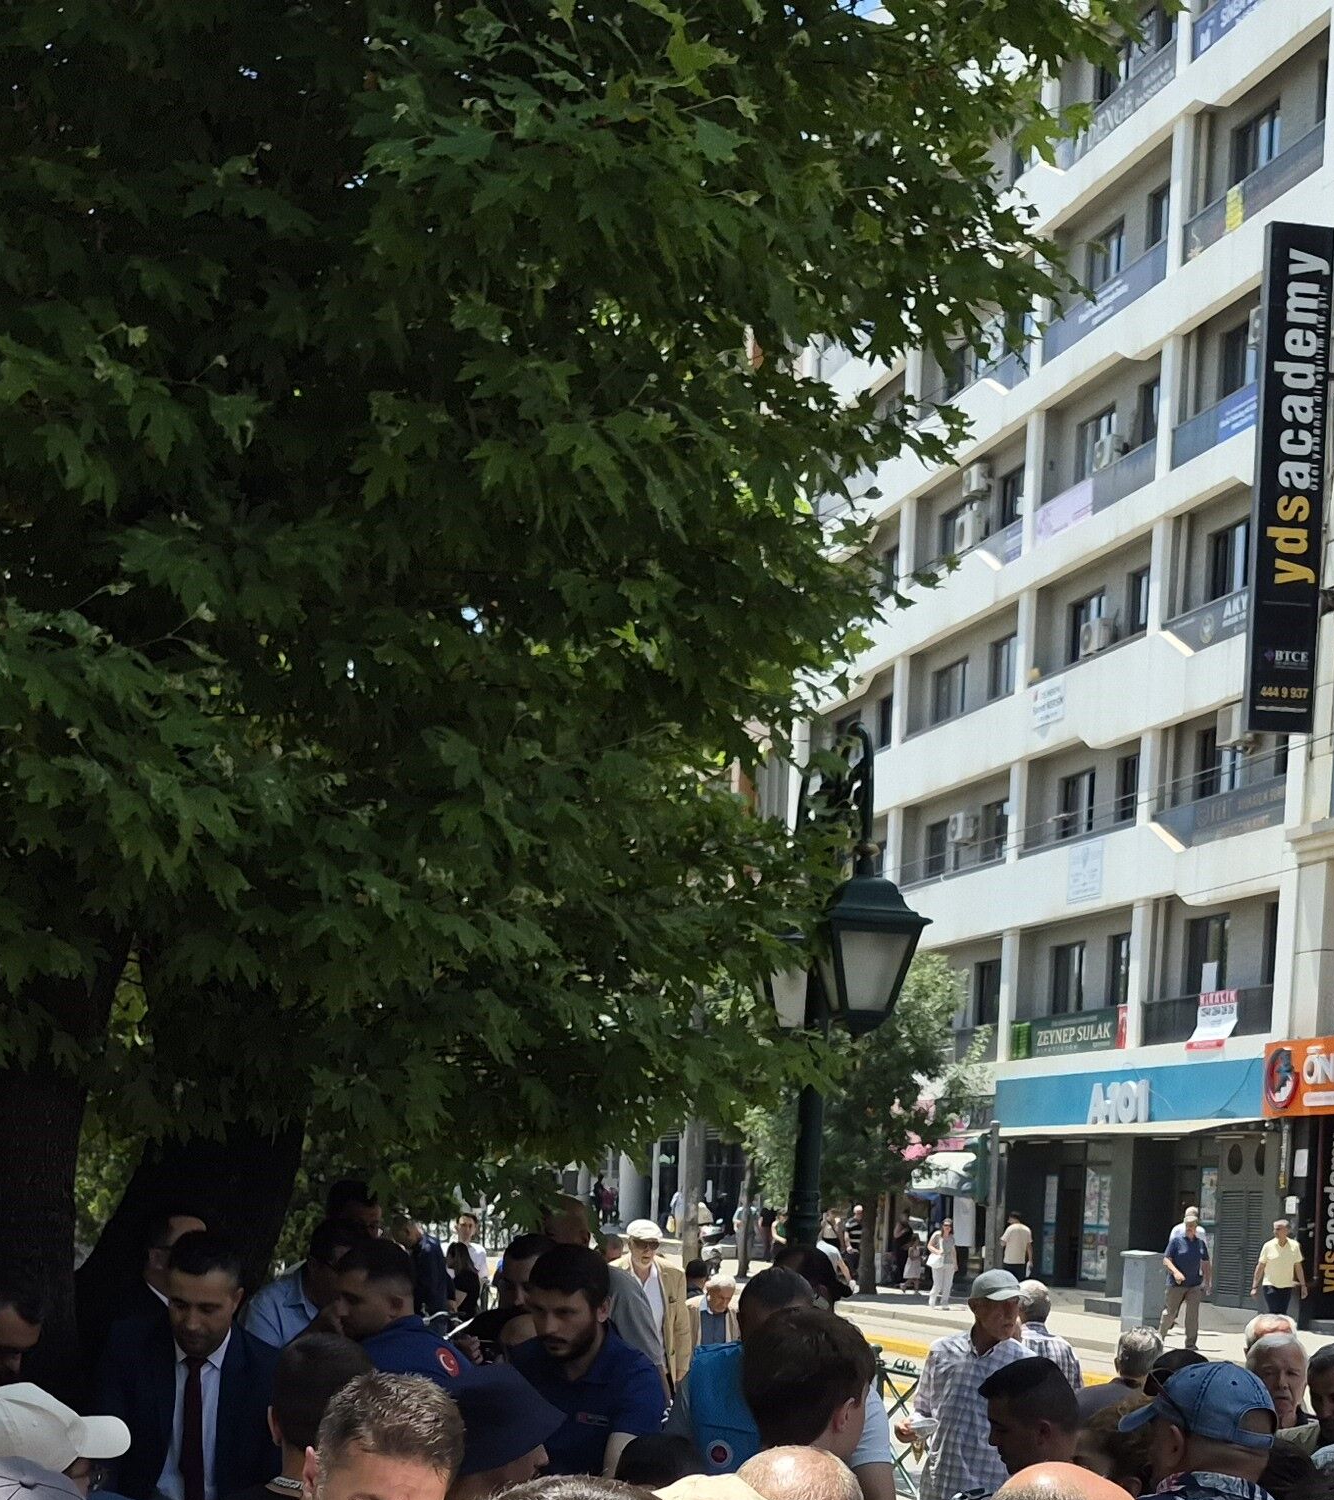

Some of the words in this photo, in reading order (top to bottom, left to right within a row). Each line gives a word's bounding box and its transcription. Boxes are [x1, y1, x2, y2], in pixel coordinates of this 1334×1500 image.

[1274, 650, 1309, 662] BTCE
[1281, 686, 1288, 698] 9
[1290, 687, 1309, 699] 937
[1036, 1027, 1076, 1047] ZEYNEP
[1077, 1021, 1113, 1042] SULAK
